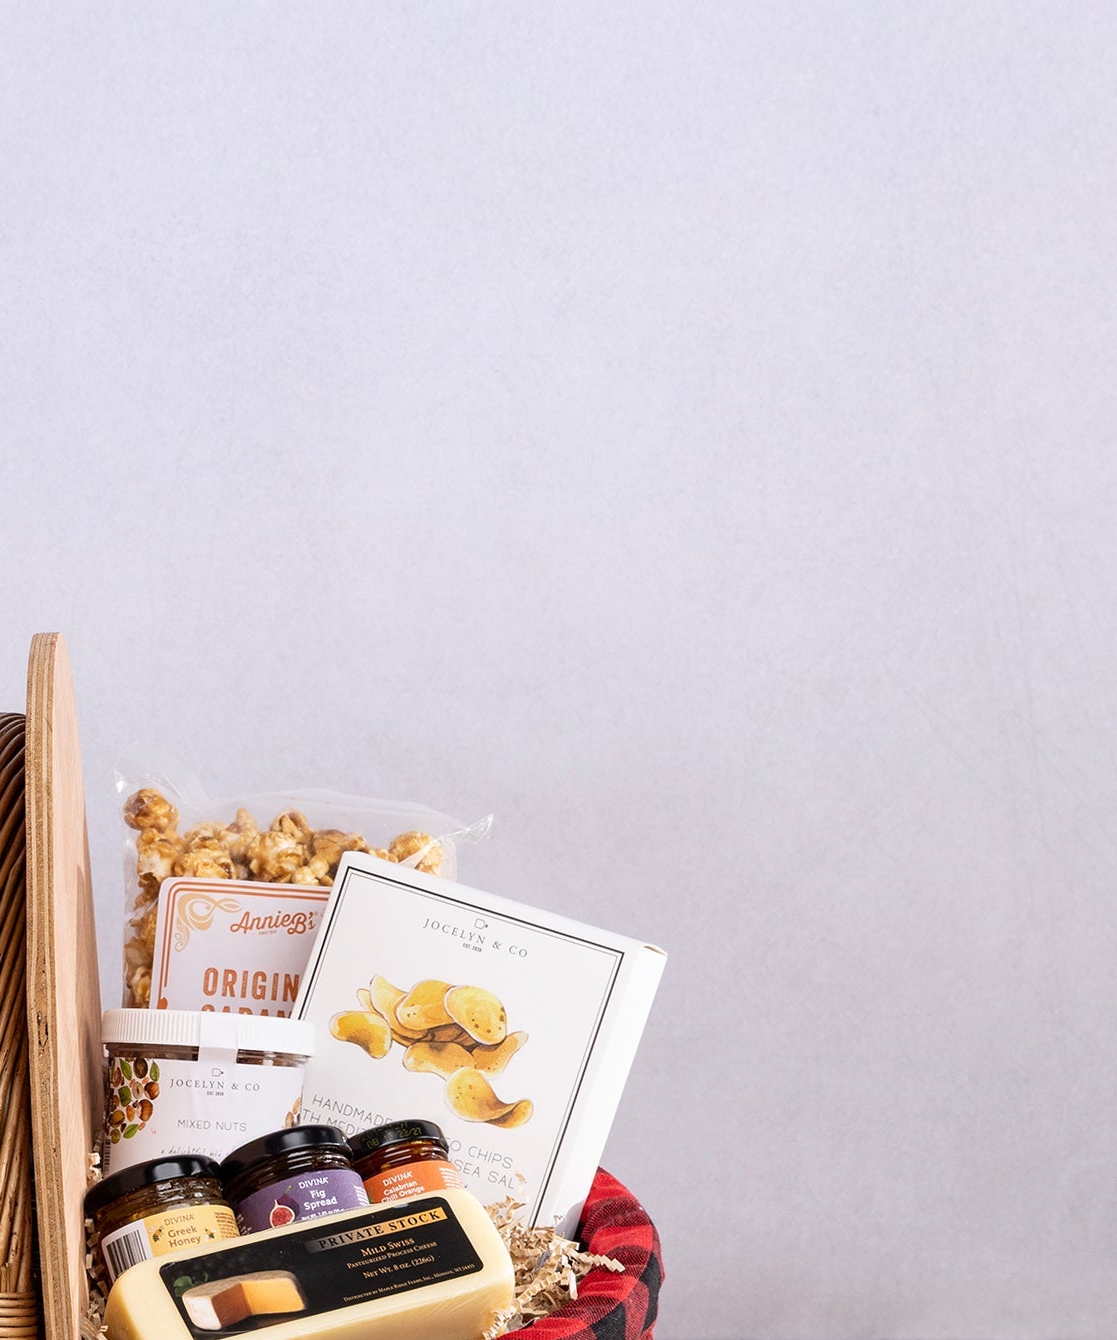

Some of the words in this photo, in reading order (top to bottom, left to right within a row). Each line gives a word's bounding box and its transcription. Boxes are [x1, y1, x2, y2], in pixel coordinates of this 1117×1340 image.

[423, 918, 486, 944] JOCELYN
[492, 941, 502, 950] &
[508, 945, 528, 958] CO
[202, 967, 300, 1003] ORIGIN
[170, 1078, 225, 1089] JOCELYN
[245, 1083, 260, 1091] CO
[177, 1119, 212, 1130] MIXED
[216, 1121, 248, 1132] NUTS
[467, 1145, 514, 1170] CHIPS
[382, 1170, 413, 1187] DIVINA
[454, 1158, 481, 1178] SEA
[487, 1170, 515, 1190] SAL
[298, 1177, 329, 1190] DIVINA
[383, 1180, 418, 1197] Calabrian
[303, 1195, 338, 1211] Spread
[310, 1189, 326, 1200] Fig
[382, 1193, 399, 1204] Chili
[399, 1185, 425, 1198] Orange
[164, 1213, 195, 1226] DIVINA
[168, 1225, 198, 1239] Greek
[318, 1225, 385, 1249] PRIVATE
[389, 1210, 441, 1231] STOCK
[169, 1235, 202, 1249] Honey
[360, 1245, 387, 1257] MILD
[388, 1237, 416, 1249] SWISS
[346, 1254, 387, 1269] PASTEURIZED
[387, 1247, 413, 1258] PROCESS
[413, 1241, 438, 1252] CHEESE
[363, 1270, 380, 1279] NET
[379, 1266, 394, 1275] WT.
[412, 1255, 435, 1268] (226G)
